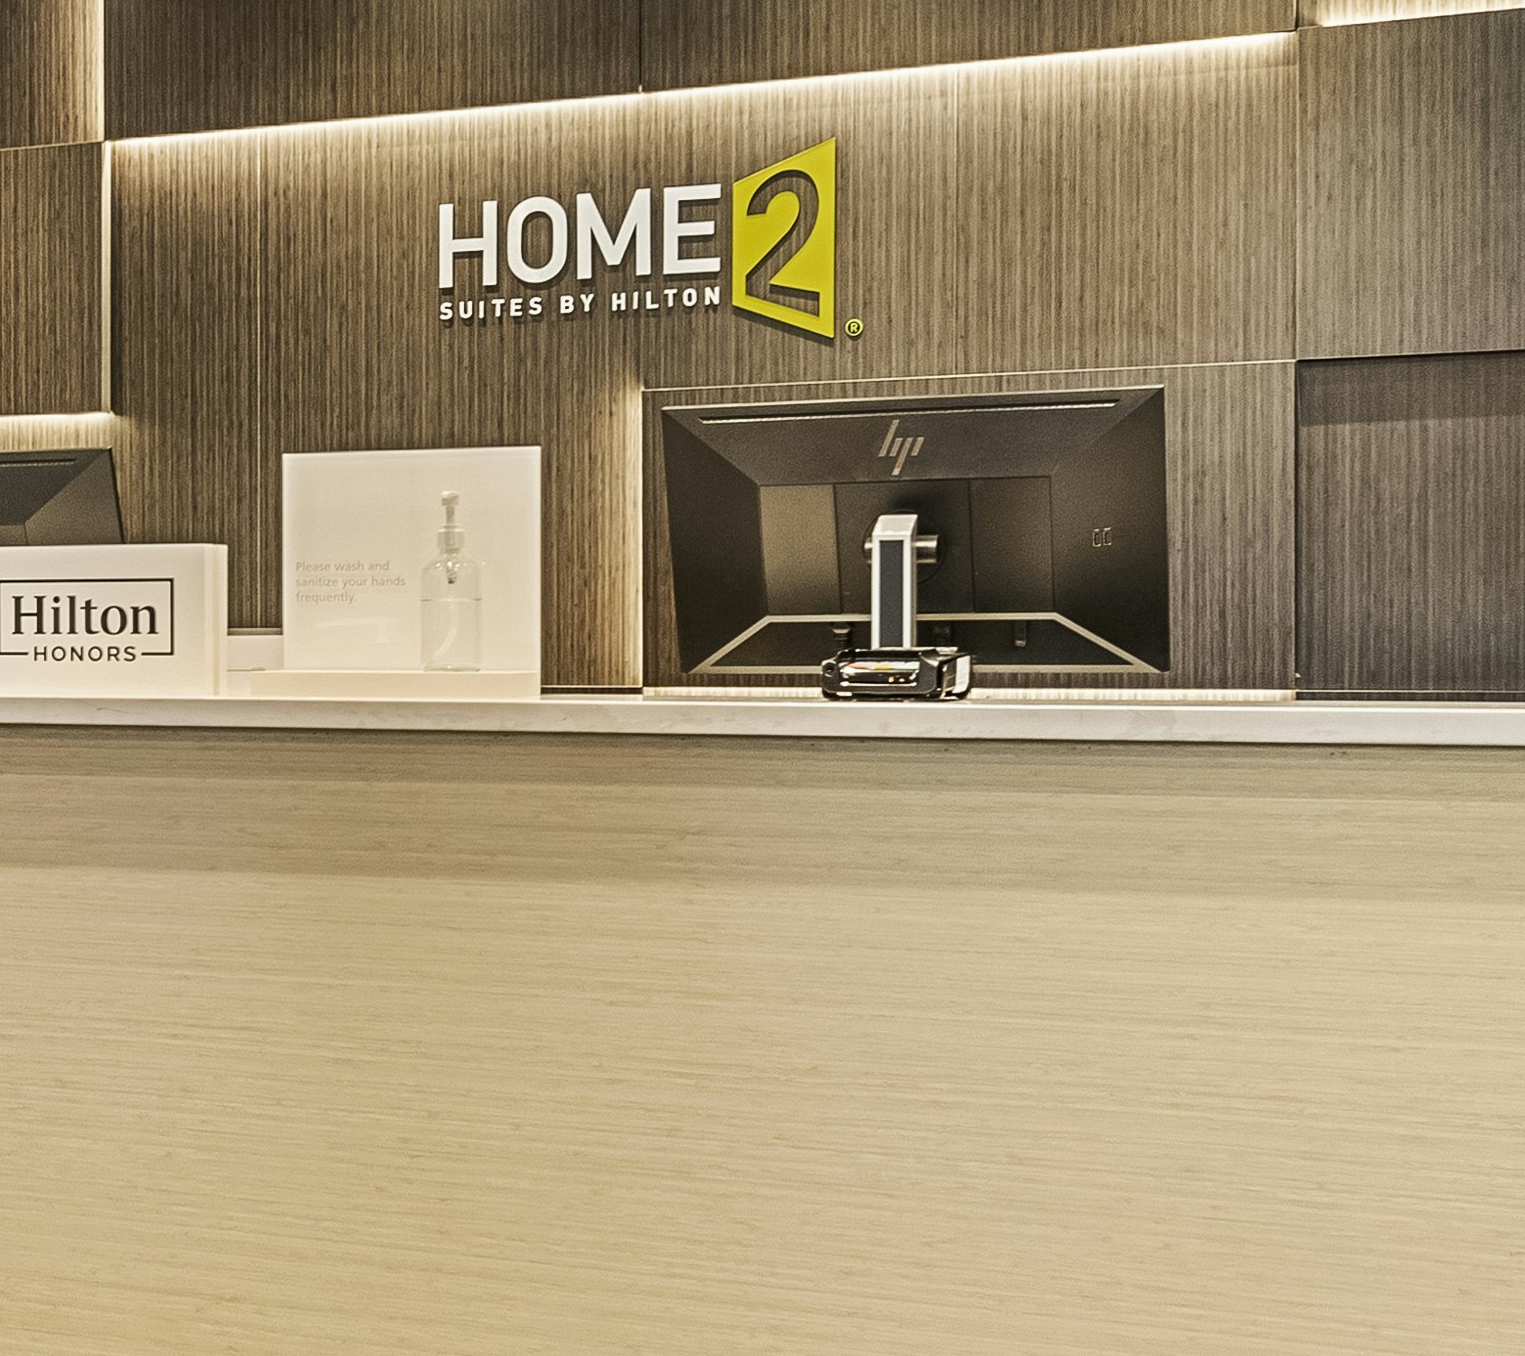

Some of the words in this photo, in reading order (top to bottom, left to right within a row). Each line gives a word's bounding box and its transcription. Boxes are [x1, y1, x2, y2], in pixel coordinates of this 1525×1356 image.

[439, 296, 543, 320] SUITES
[560, 292, 595, 314] BY
[611, 286, 722, 312] HILTON
[877, 419, 924, 475] hp
[296, 561, 331, 572] Please
[334, 561, 364, 572] wash
[367, 560, 390, 572] and
[296, 577, 339, 587] sanitize
[341, 578, 368, 589] your
[371, 576, 406, 587] hands
[12, 595, 159, 636] Hilton
[33, 646, 137, 662] HONORS
